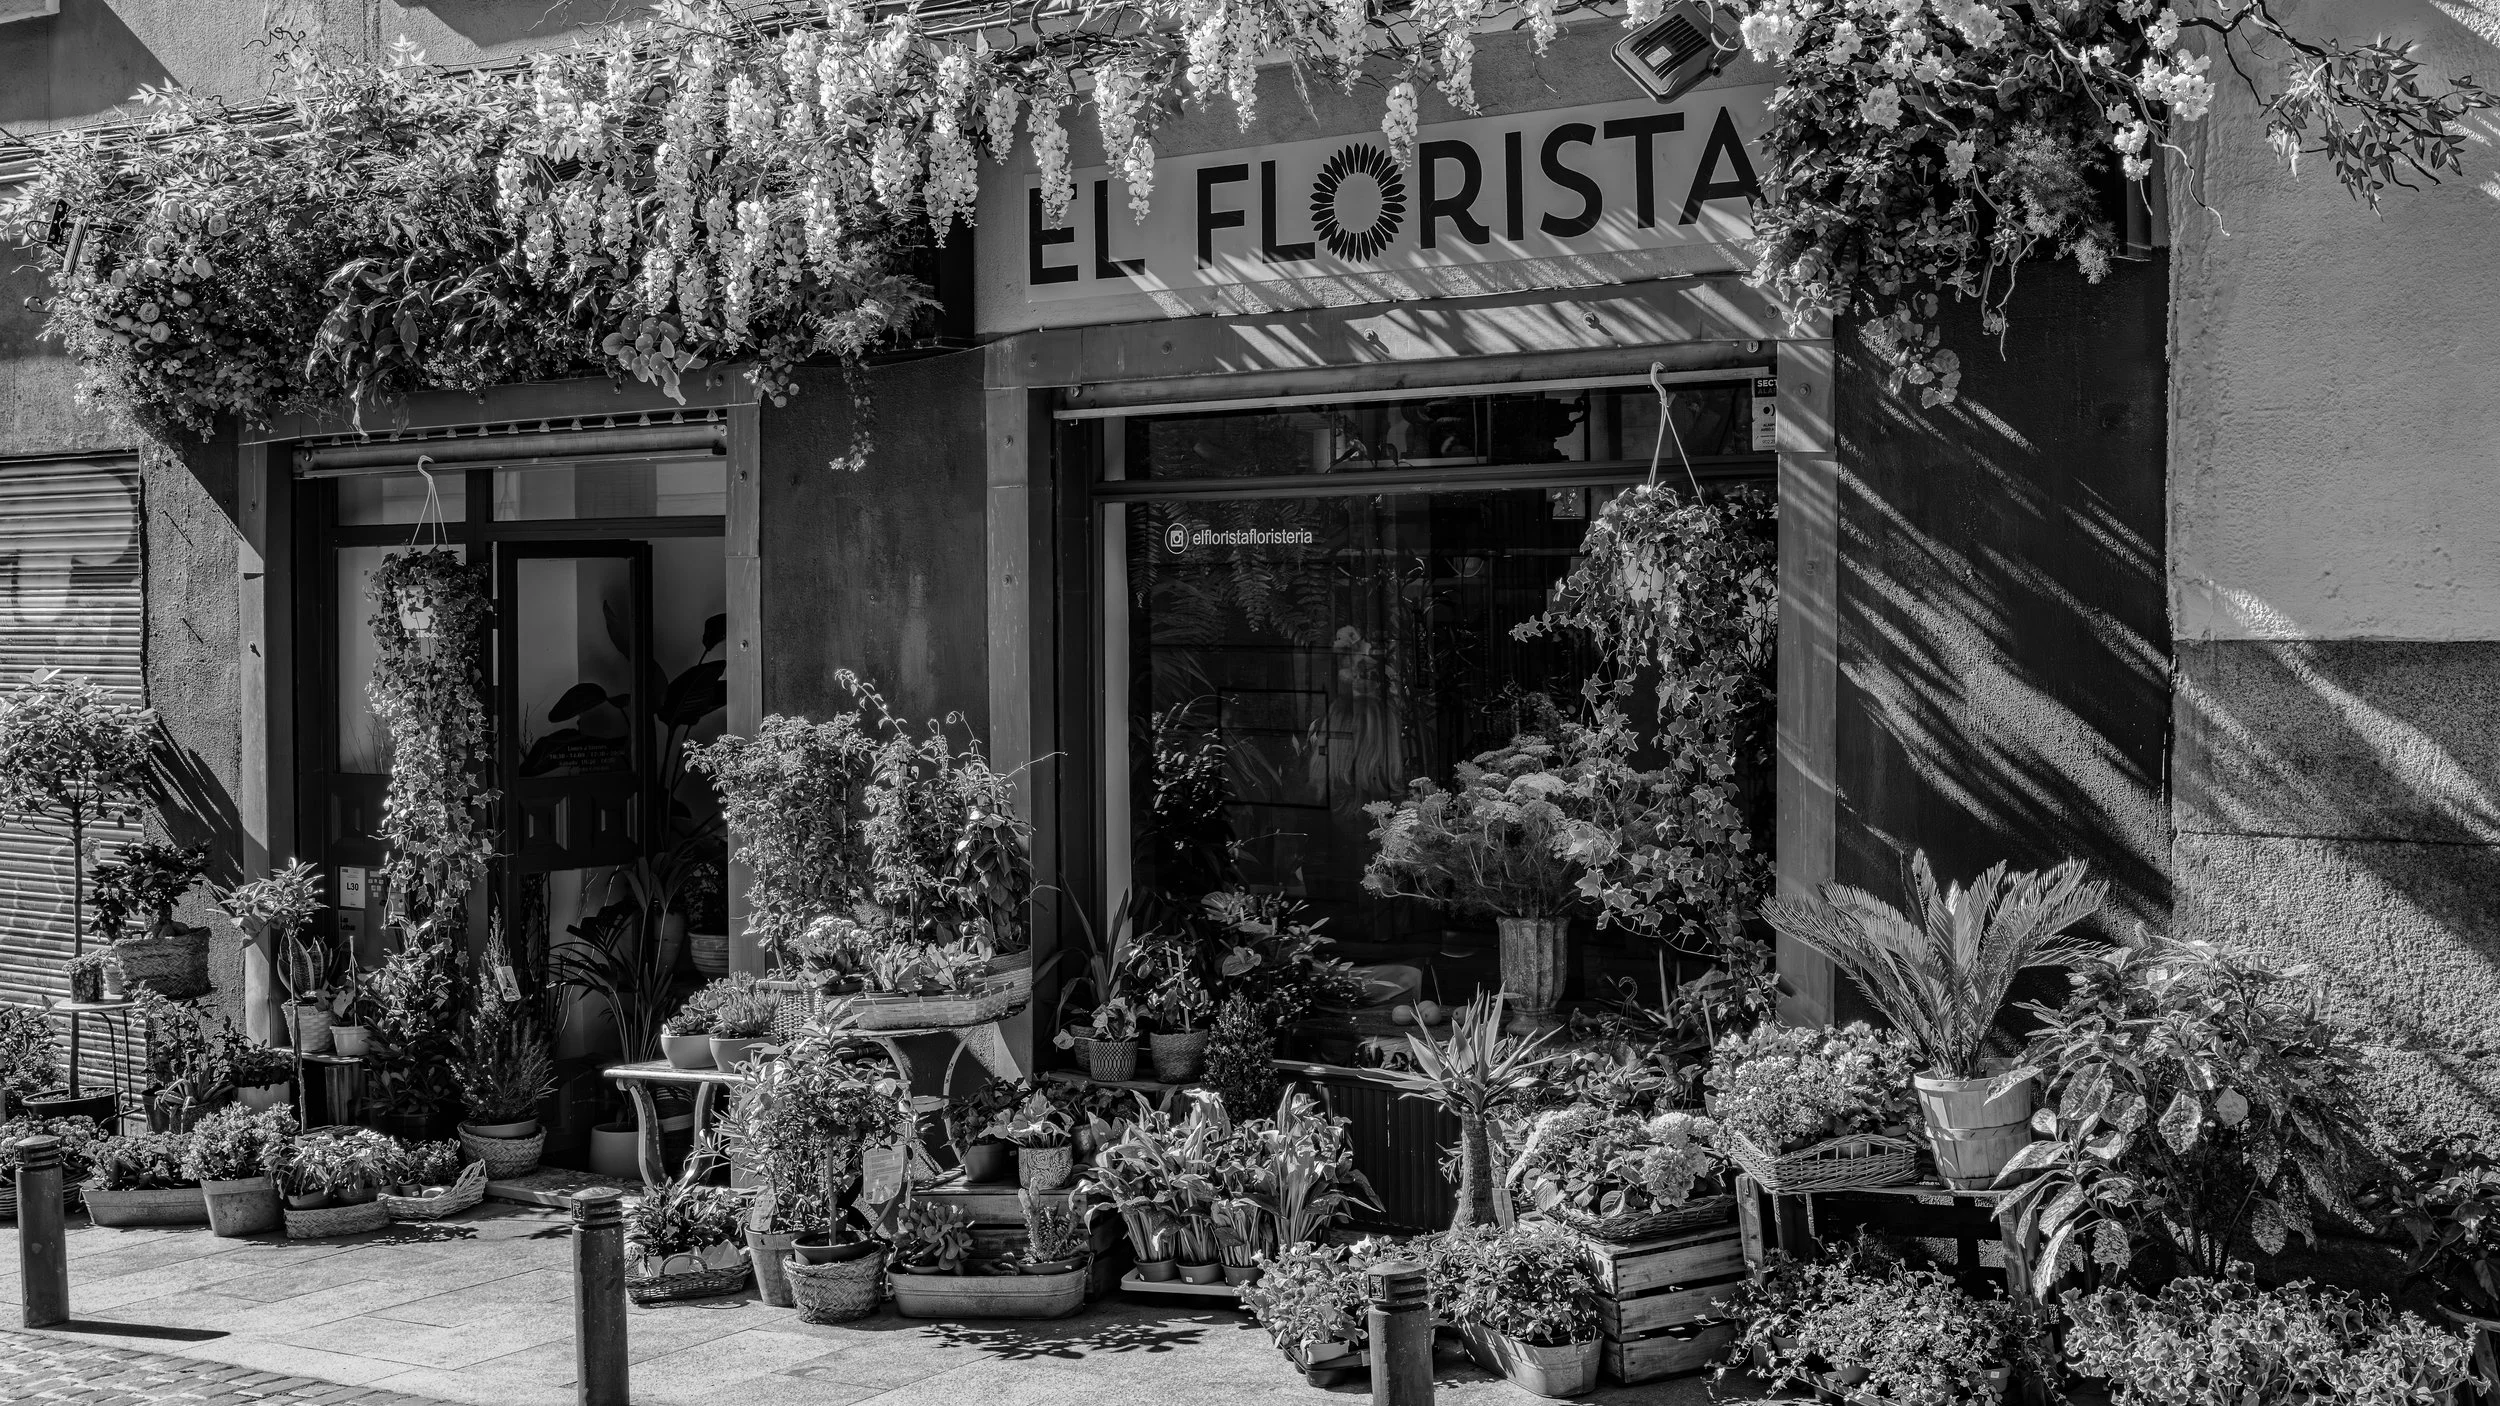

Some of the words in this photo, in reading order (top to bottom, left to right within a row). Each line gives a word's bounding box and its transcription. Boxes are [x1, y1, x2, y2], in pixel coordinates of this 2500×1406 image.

[1029, 179, 1145, 285] EL
[1197, 106, 1769, 269] FLORISTA
[1192, 528, 1313, 545] elfloristafloristeria
[347, 883, 359, 891] L30
